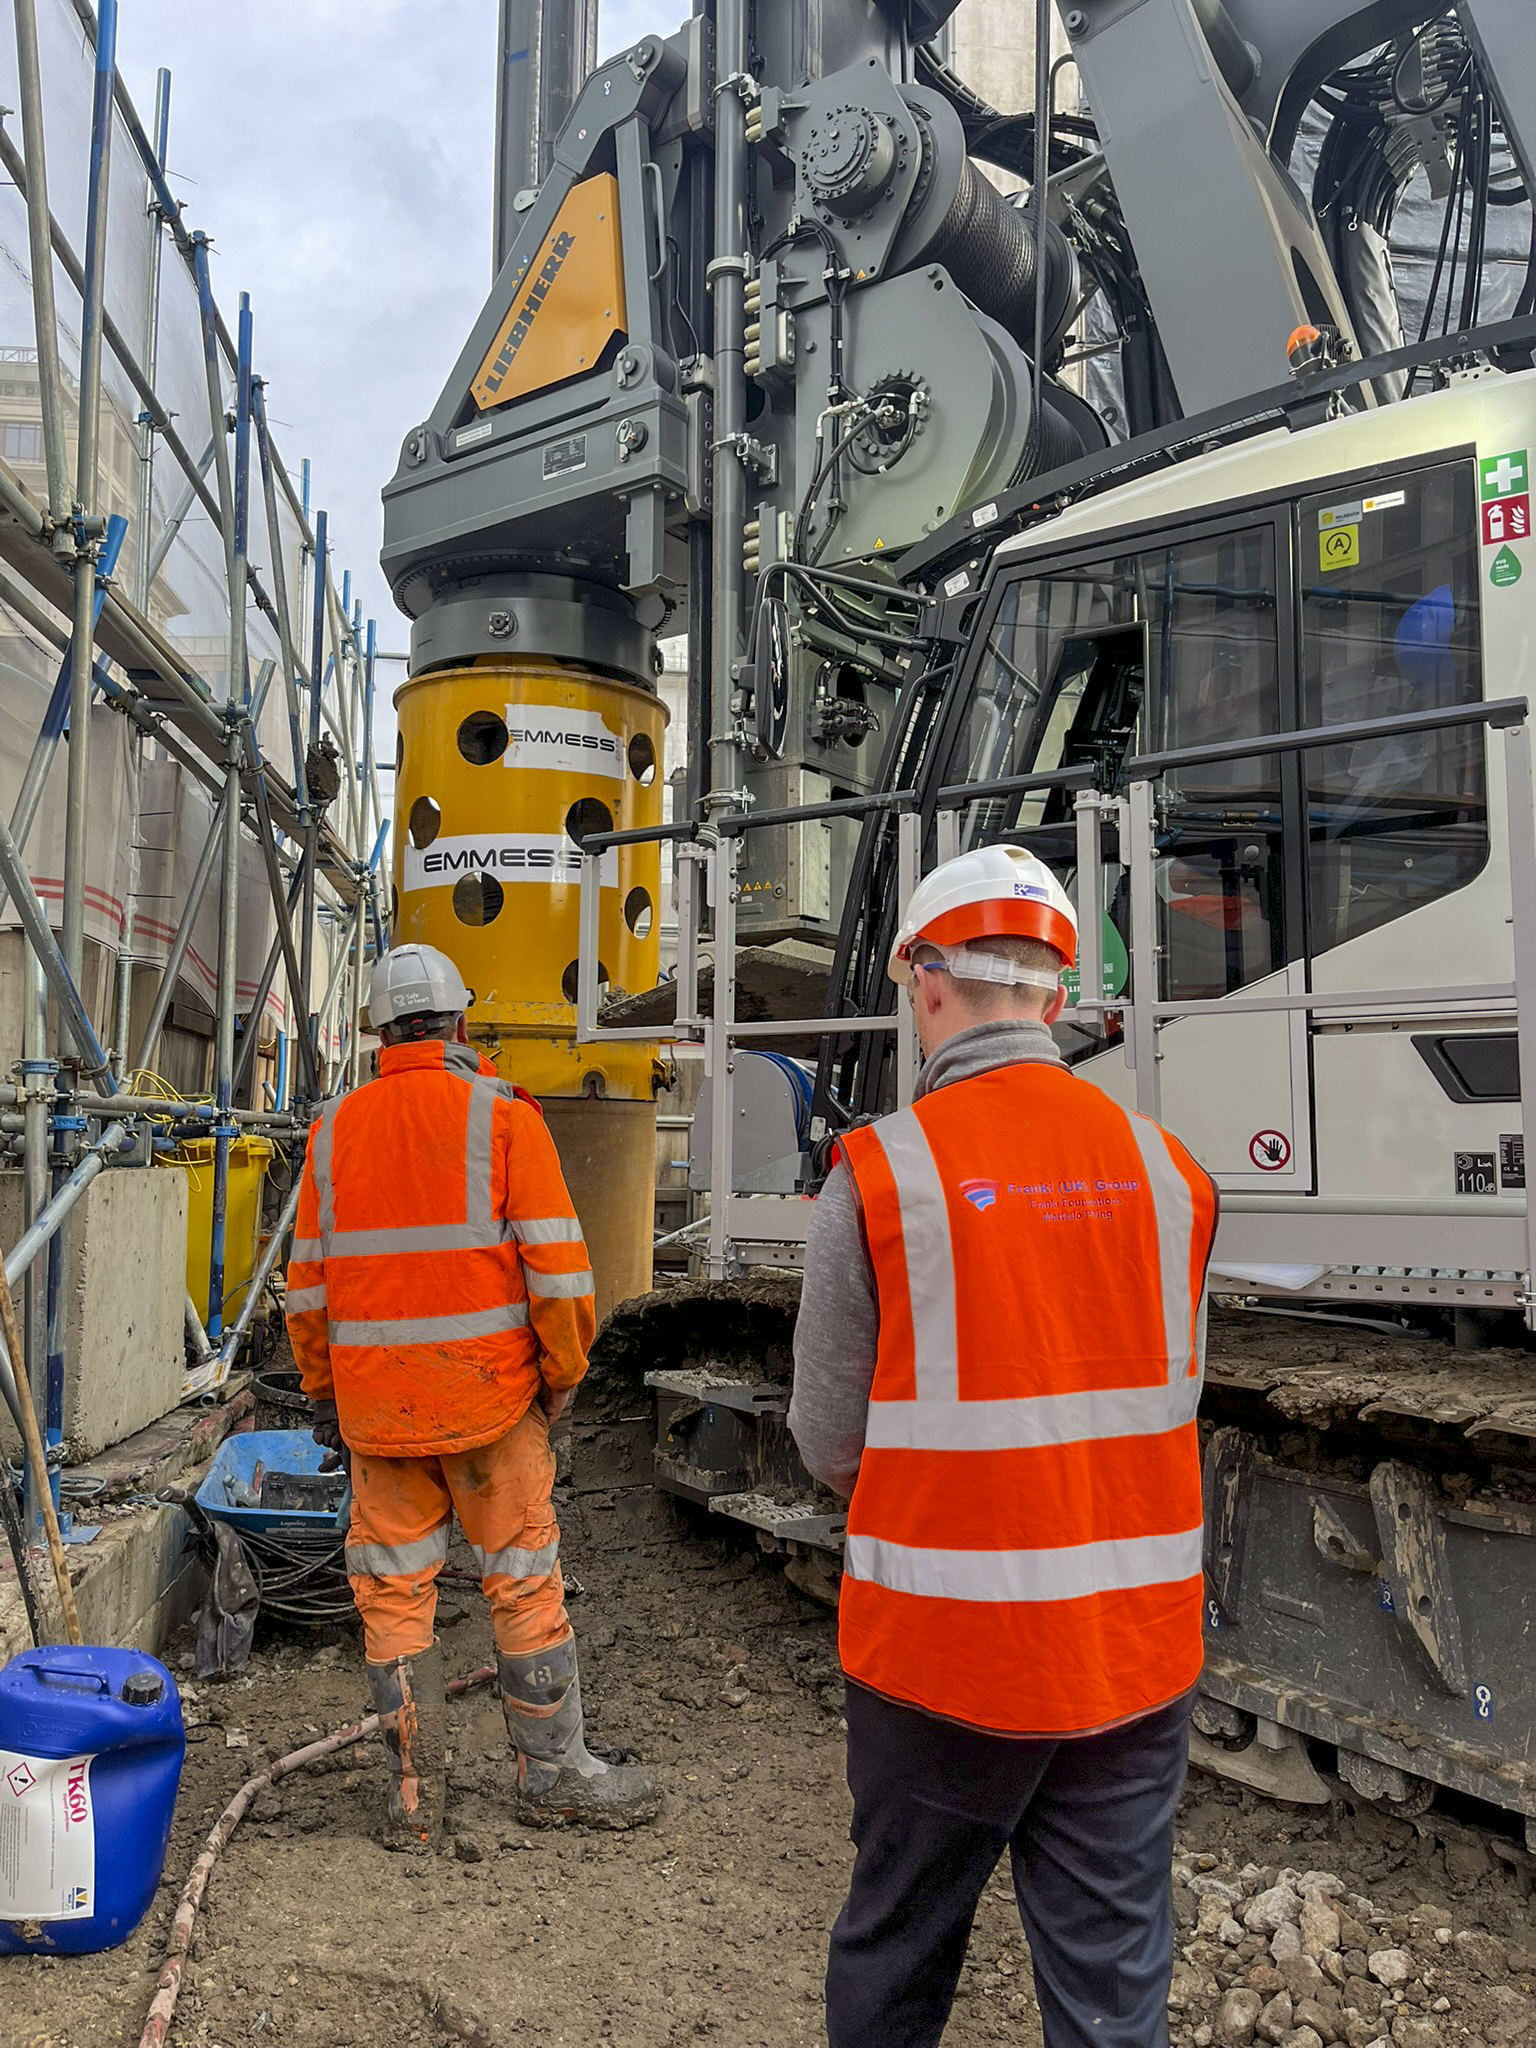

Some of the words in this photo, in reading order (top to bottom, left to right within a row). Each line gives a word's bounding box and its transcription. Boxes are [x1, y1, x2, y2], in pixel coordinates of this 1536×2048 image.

[484, 231, 576, 393] LIEBHERR
[1333, 538, 1344, 550] A
[509, 729, 615, 752] EMMESS
[424, 848, 584, 873] EMMESS
[1007, 1182, 1053, 1194] Franki
[1058, 1180, 1090, 1195] (UK)
[1094, 1179, 1140, 1192] Group
[1029, 1199, 1059, 1209] Franki
[1061, 1196, 1123, 1208] Foundations
[1043, 1211, 1083, 1222] Martello
[1085, 1209, 1113, 1220] Piling
[68, 1759, 88, 1823] TK60
